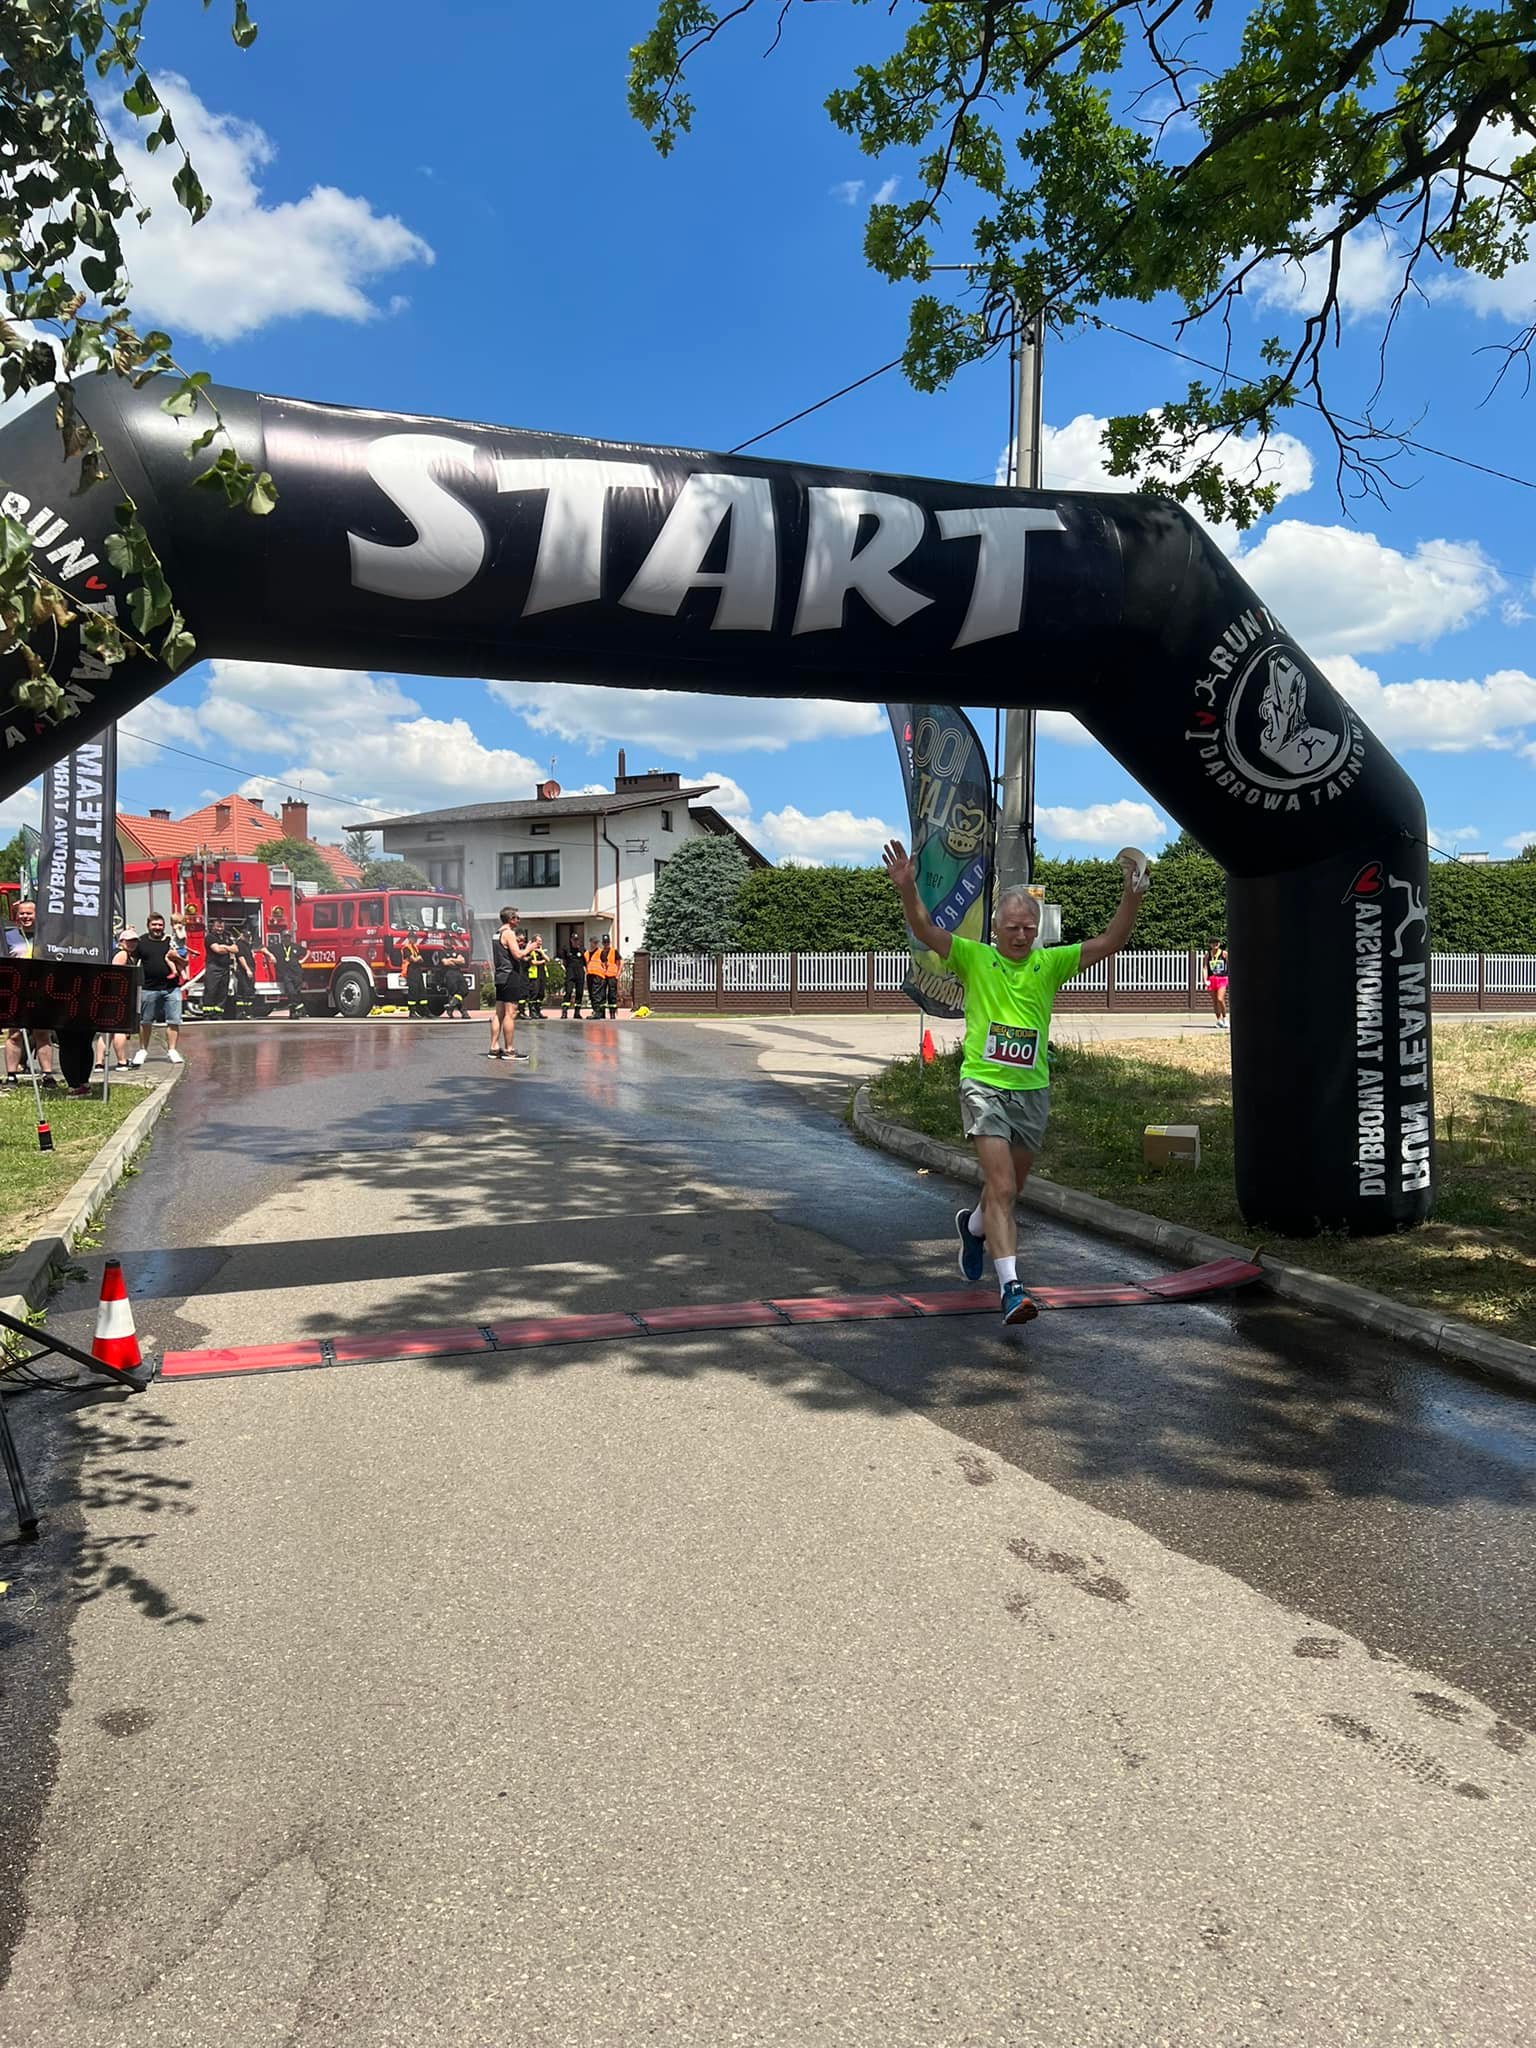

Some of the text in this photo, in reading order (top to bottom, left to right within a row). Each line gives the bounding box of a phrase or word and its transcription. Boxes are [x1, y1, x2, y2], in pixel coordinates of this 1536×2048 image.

[1, 491, 99, 581] RUN
[346, 433, 1067, 650] START
[1208, 608, 1264, 674] RUN
[1200, 744, 1300, 811] DĄBROWA
[1000, 1041, 1033, 1060] 100
